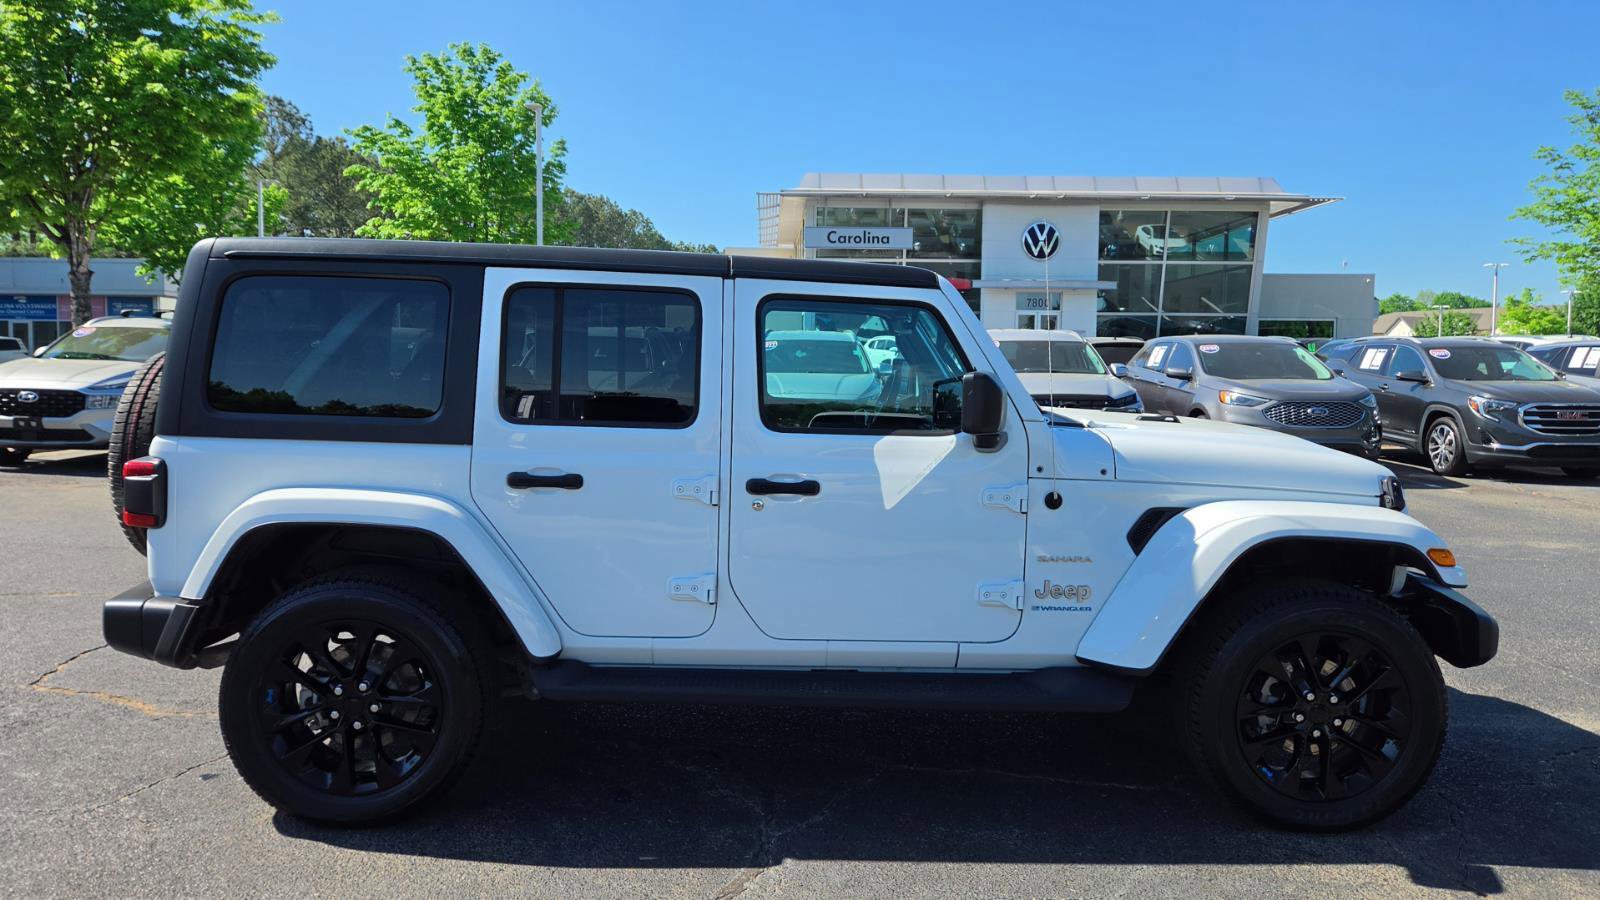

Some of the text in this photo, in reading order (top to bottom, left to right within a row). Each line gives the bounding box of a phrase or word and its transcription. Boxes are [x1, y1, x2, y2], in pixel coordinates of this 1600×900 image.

[826, 230, 890, 244] Carolina
[1037, 555, 1093, 563] SAHARA
[1034, 579, 1092, 603] Jeep
